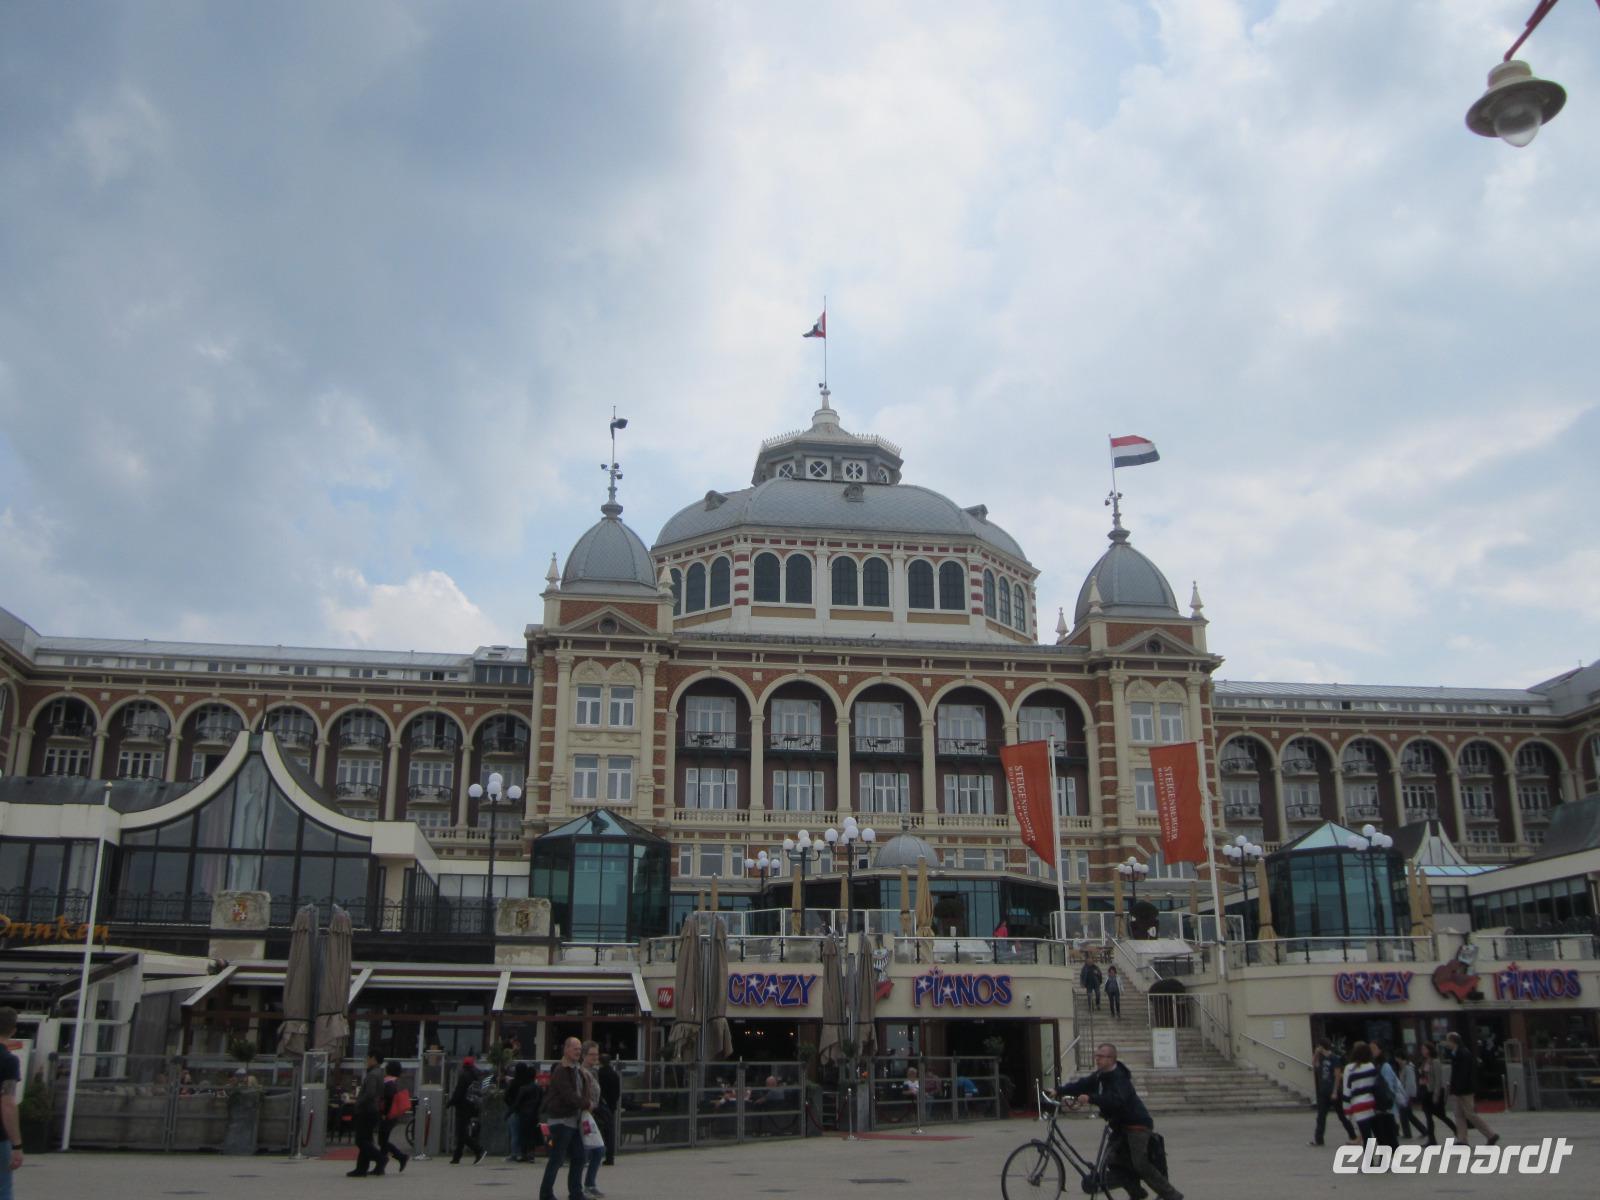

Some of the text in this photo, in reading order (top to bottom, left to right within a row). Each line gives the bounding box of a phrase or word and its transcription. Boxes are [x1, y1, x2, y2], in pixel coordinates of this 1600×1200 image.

[727, 968, 1012, 1008] CRAZY PIANOS
[1335, 966, 1582, 1003] CRAZY PIANOS
